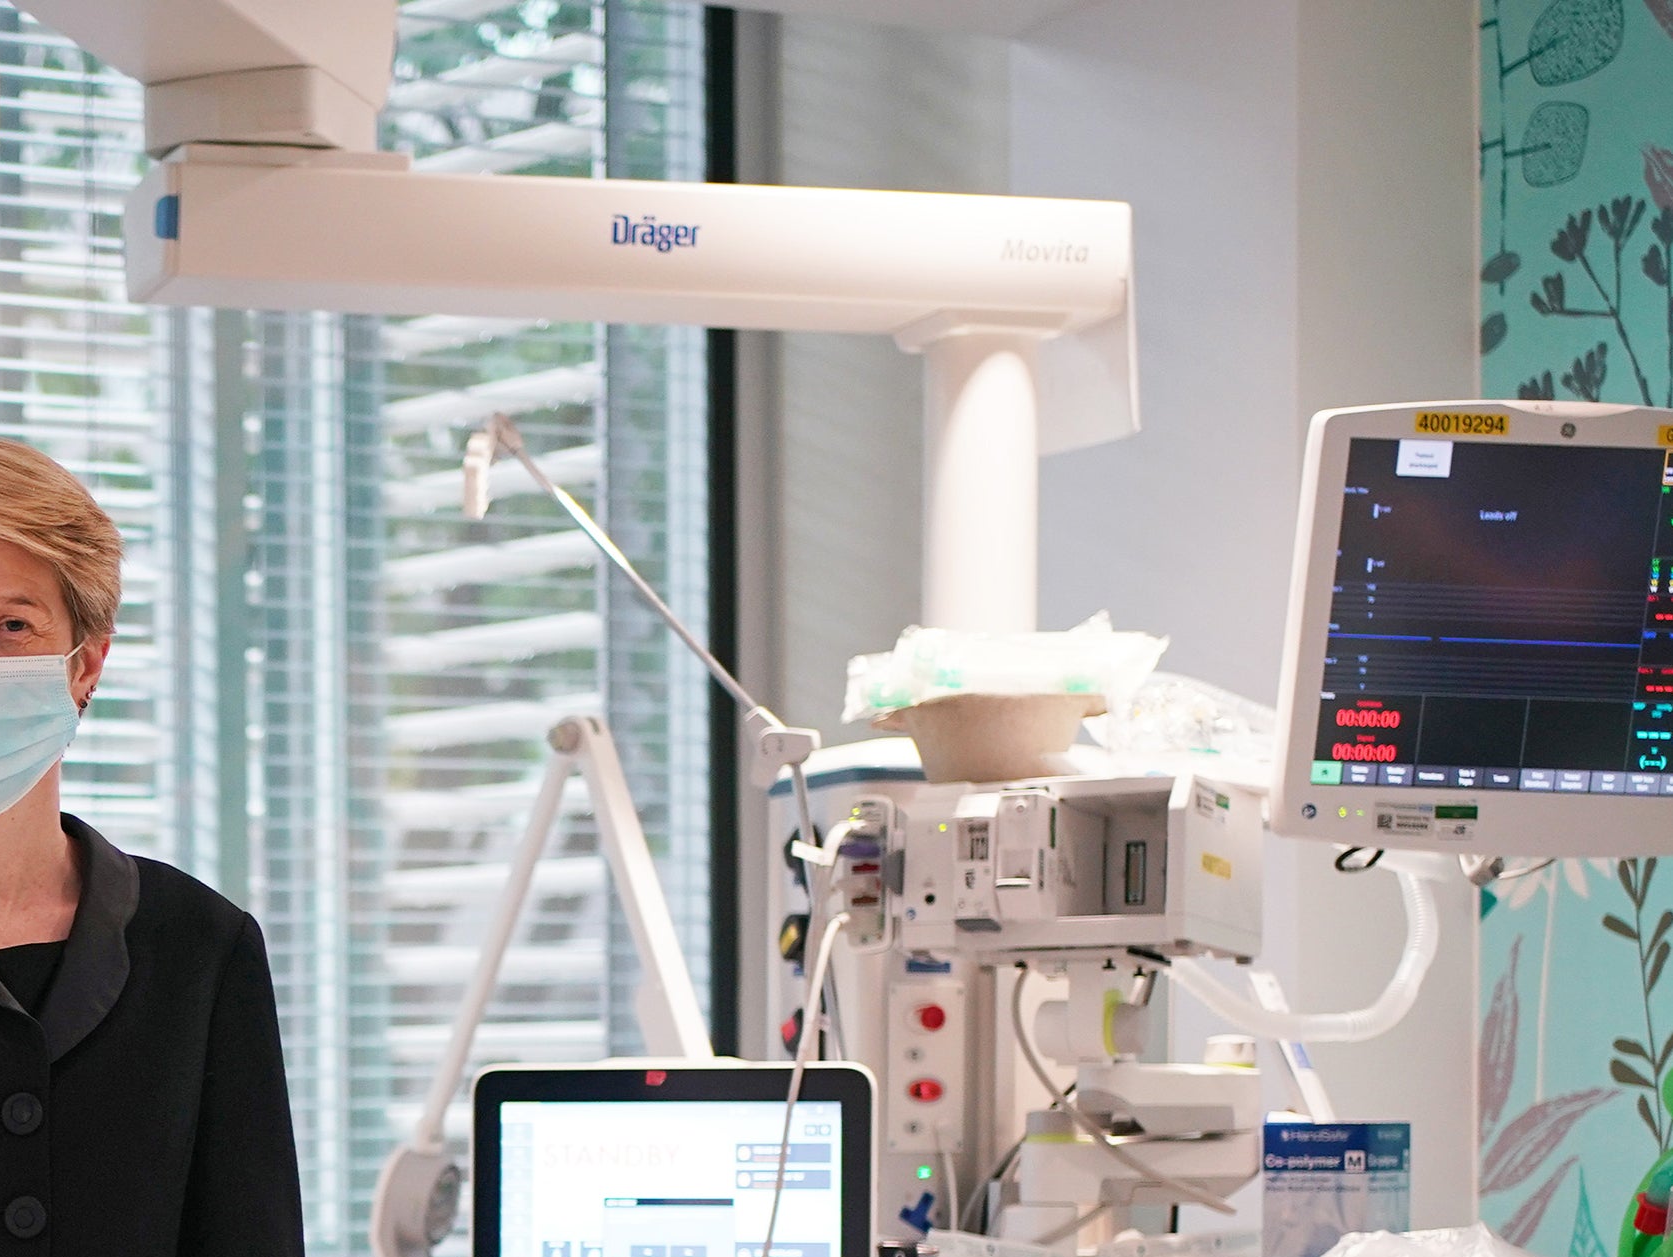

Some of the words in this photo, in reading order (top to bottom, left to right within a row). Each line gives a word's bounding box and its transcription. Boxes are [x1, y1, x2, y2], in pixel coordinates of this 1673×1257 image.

[611, 214, 700, 252] Dräger
[1000, 239, 1090, 265] Movita
[1418, 413, 1505, 434] 40019294
[1336, 709, 1401, 728] 00:00:00
[1332, 743, 1397, 762] 00:00:00
[1347, 1155, 1362, 1168] M
